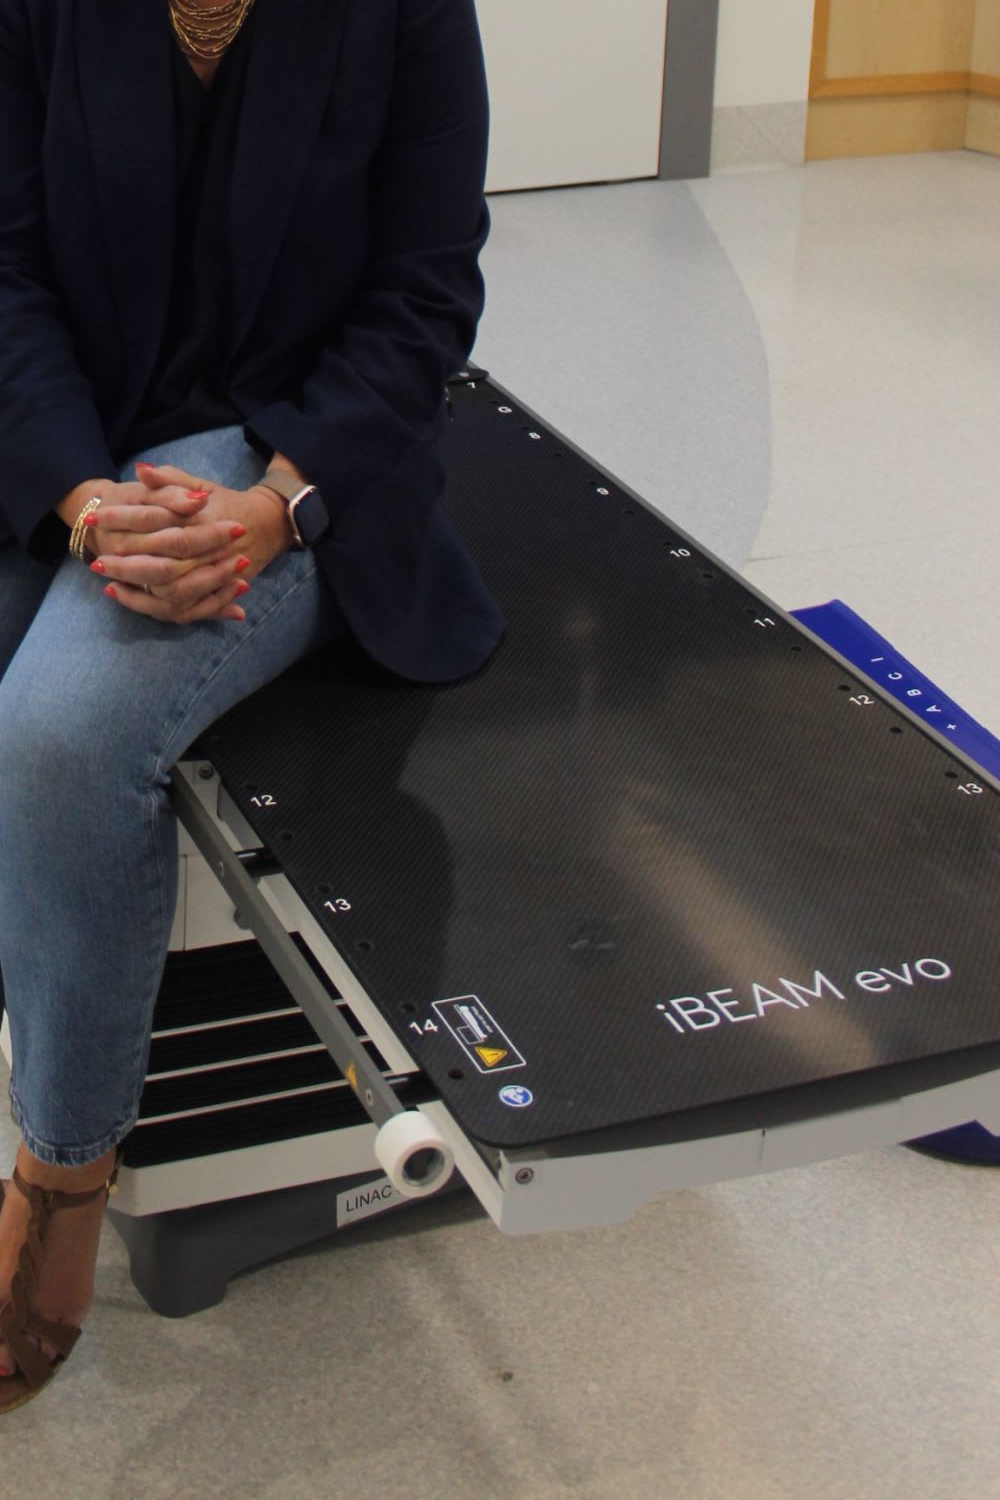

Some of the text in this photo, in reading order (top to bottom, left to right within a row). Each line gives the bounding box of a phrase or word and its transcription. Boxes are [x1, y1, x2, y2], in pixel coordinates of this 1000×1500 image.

[669, 548, 691, 558] 10
[753, 616, 776, 628] 11
[849, 694, 875, 706] 12
[957, 782, 983, 795] 13
[250, 794, 277, 807] 12
[323, 898, 352, 913] 13
[656, 958, 951, 1033] iBEAM evo
[409, 1018, 438, 1035] 14
[346, 1185, 392, 1212] LINAC
